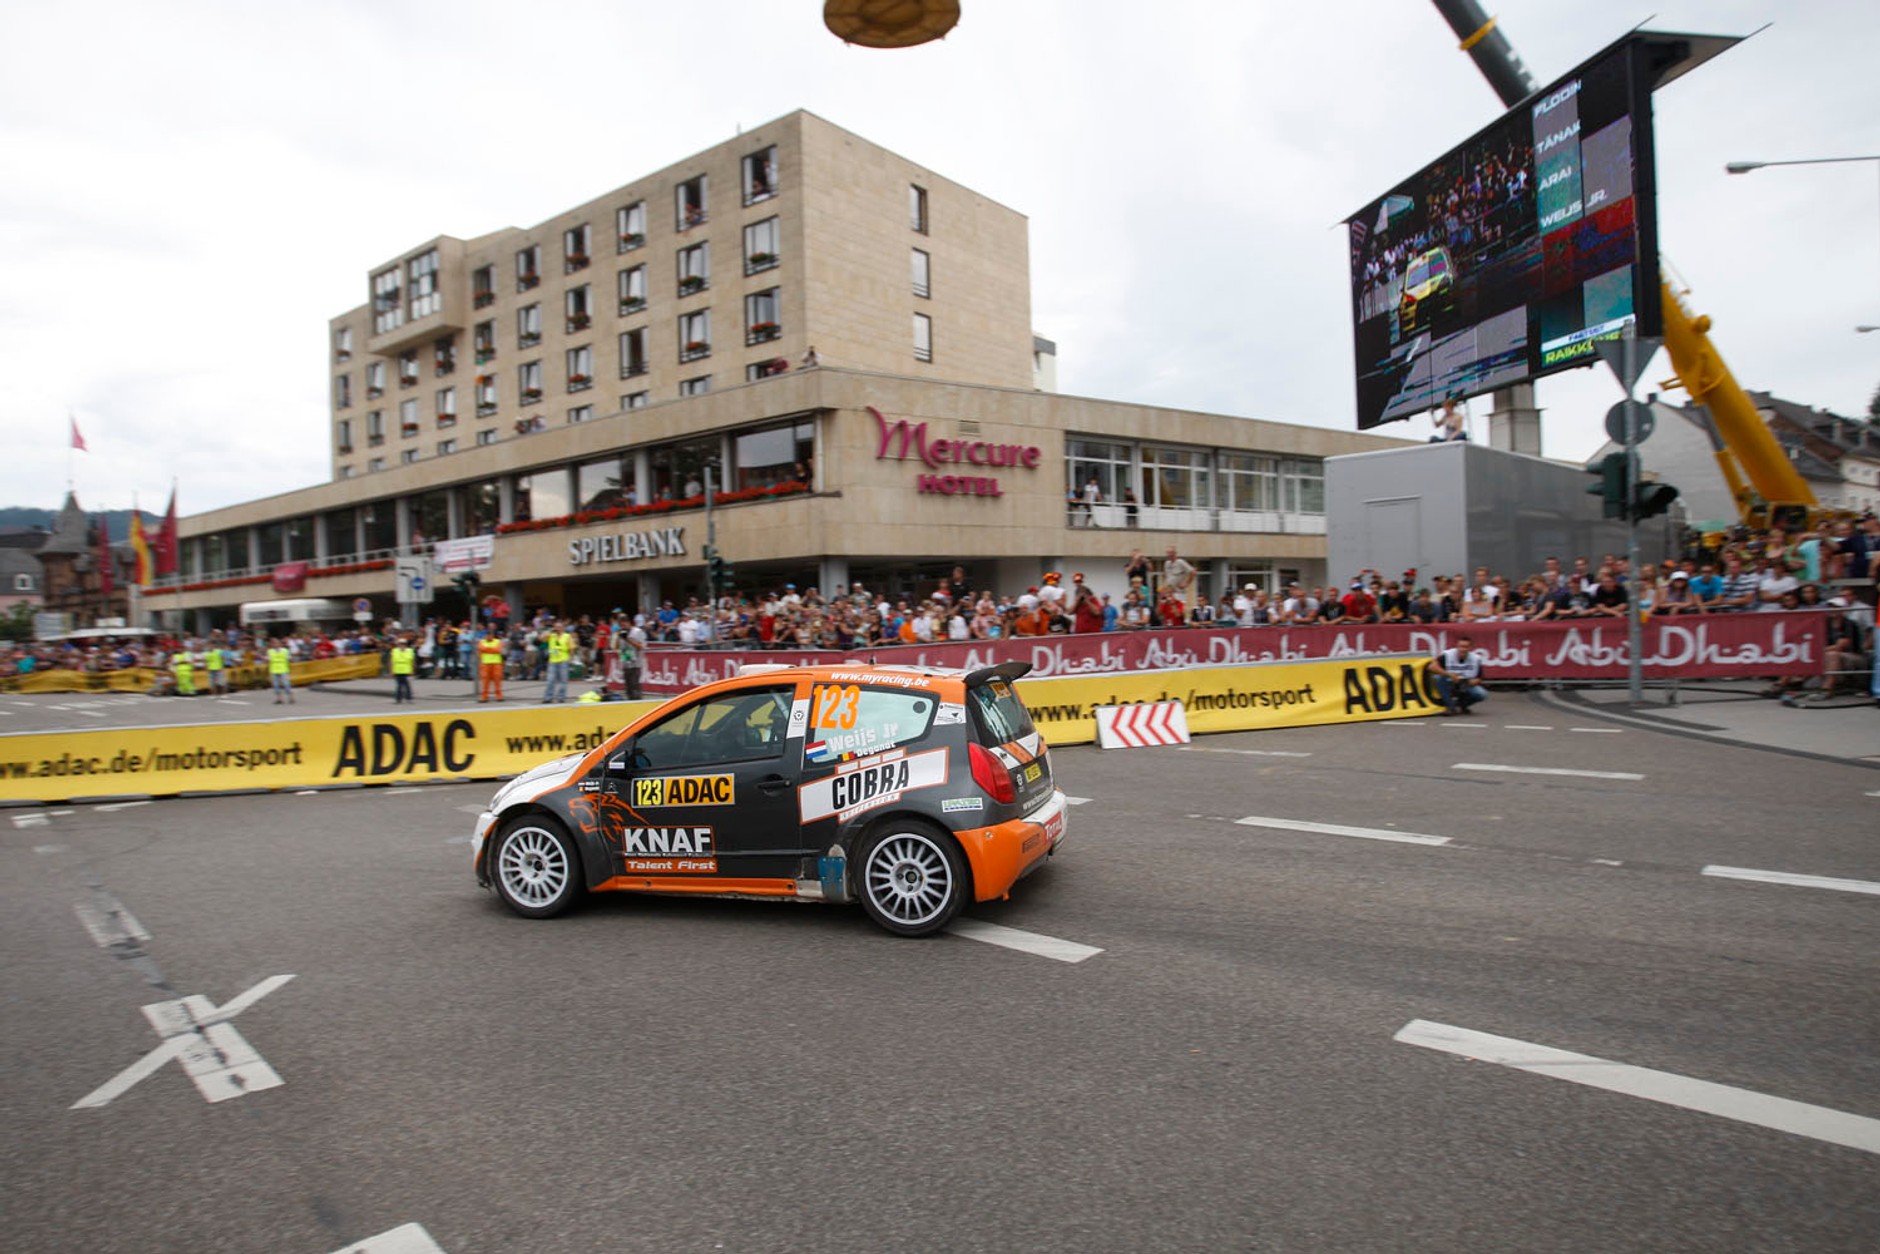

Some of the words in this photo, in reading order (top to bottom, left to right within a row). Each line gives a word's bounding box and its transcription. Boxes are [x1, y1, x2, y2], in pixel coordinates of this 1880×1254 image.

[1539, 166, 1572, 191] ARAI
[865, 405, 1042, 469] Mercure
[917, 474, 1005, 497] HOTEL
[569, 527, 686, 565] SPIELBANK
[1031, 643, 1126, 677] Dhabi
[1655, 621, 1816, 667] Dhabi
[830, 671, 930, 688] www.myracing.be
[809, 684, 861, 731] 123
[331, 719, 476, 778] ADAC
[636, 779, 662, 806] 123
[668, 777, 730, 804] ADAC
[832, 760, 910, 810] COBRA
[624, 828, 711, 854] KNAF
[628, 861, 673, 870] Talent
[677, 861, 716, 870] First
